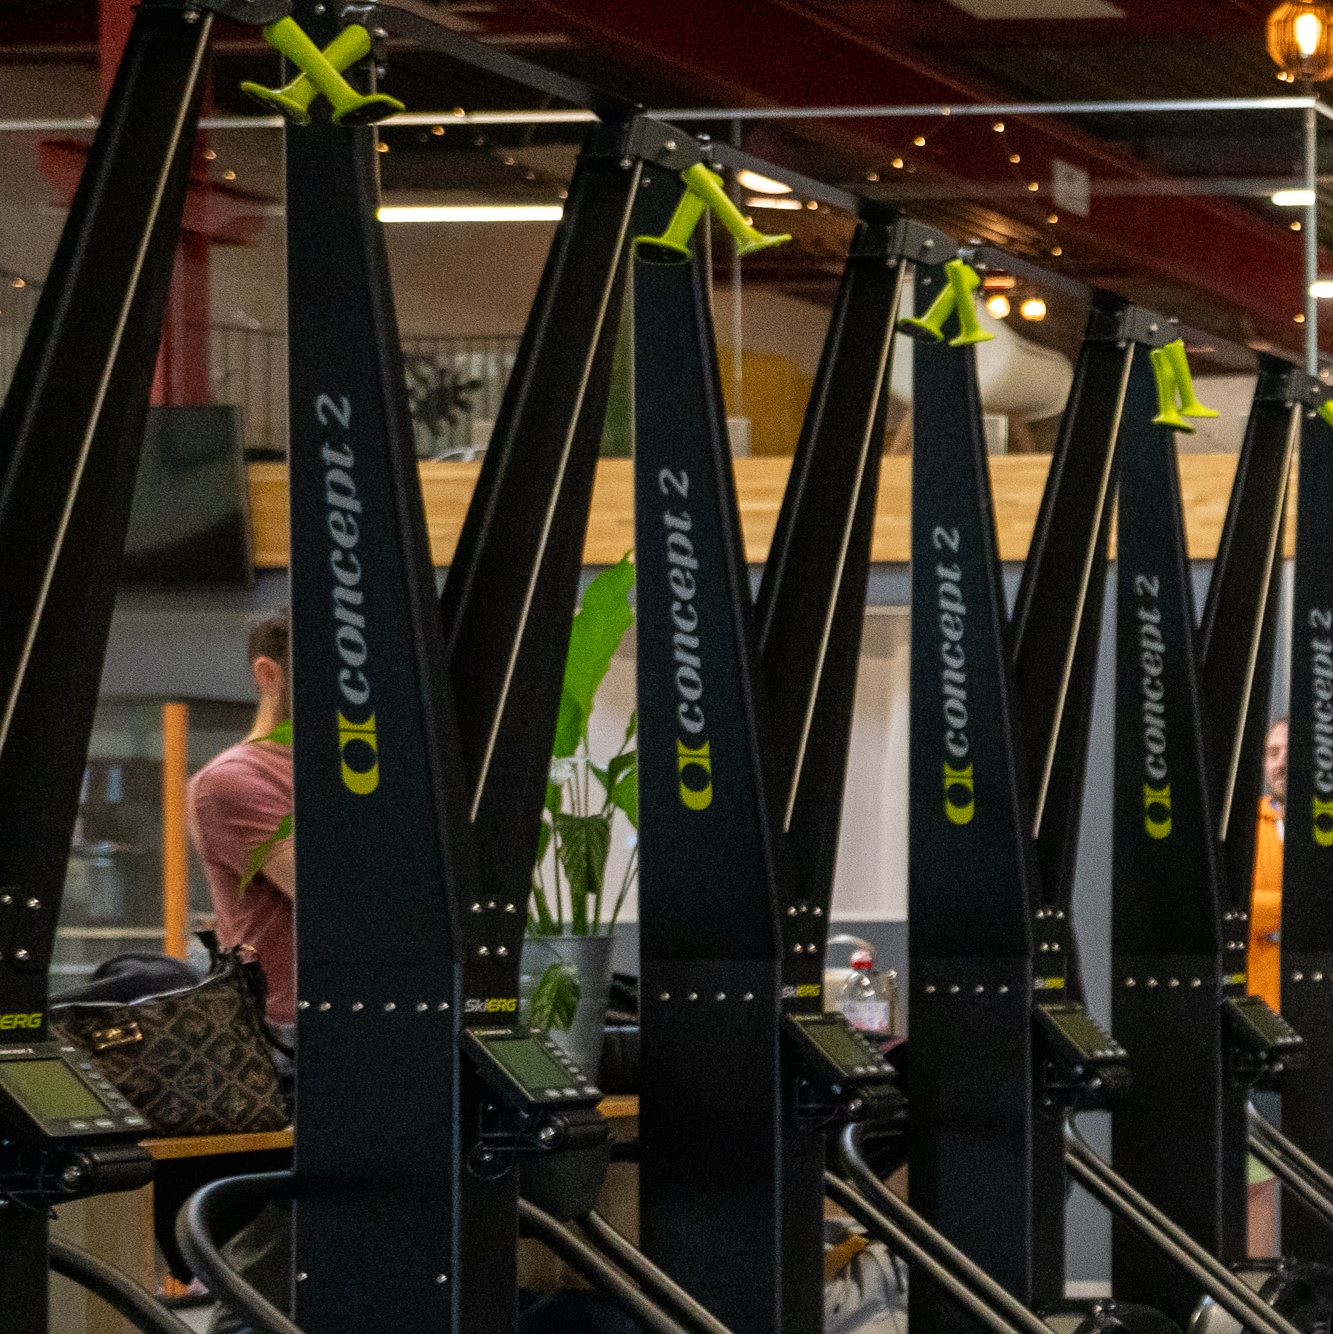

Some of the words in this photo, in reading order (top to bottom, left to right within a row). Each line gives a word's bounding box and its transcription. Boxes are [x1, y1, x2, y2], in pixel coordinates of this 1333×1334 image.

[315, 392, 351, 429] 2
[658, 468, 690, 499] 2
[932, 525, 961, 553] 2
[321, 442, 370, 705] concept
[1133, 574, 1161, 598] 2
[662, 510, 706, 734] concept
[1308, 608, 1333, 631] 2
[936, 562, 969, 758] concept
[1137, 606, 1168, 780] concept
